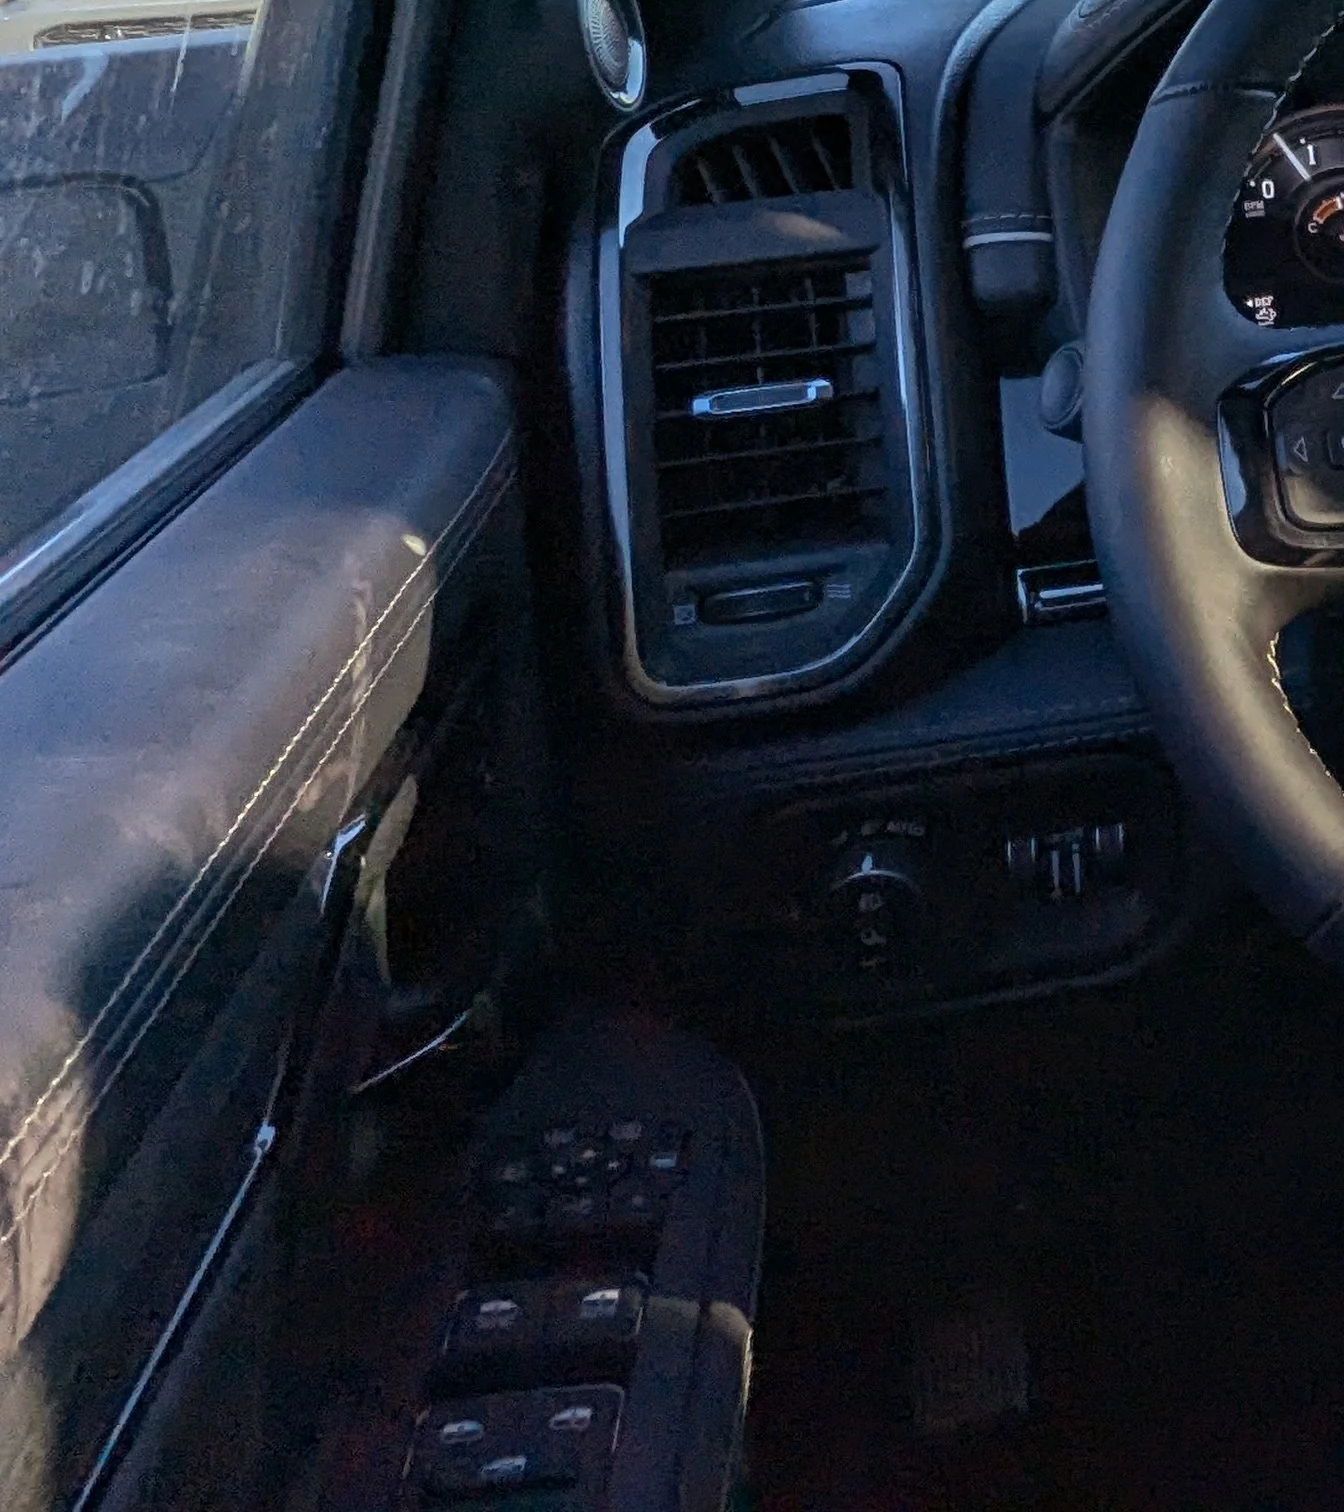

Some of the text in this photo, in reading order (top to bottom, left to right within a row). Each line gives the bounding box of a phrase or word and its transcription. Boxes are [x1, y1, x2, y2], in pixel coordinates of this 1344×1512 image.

[1306, 143, 1317, 166] 1
[1261, 179, 1275, 199] 0
[1307, 222, 1318, 234] C
[1254, 295, 1275, 308] DEF
